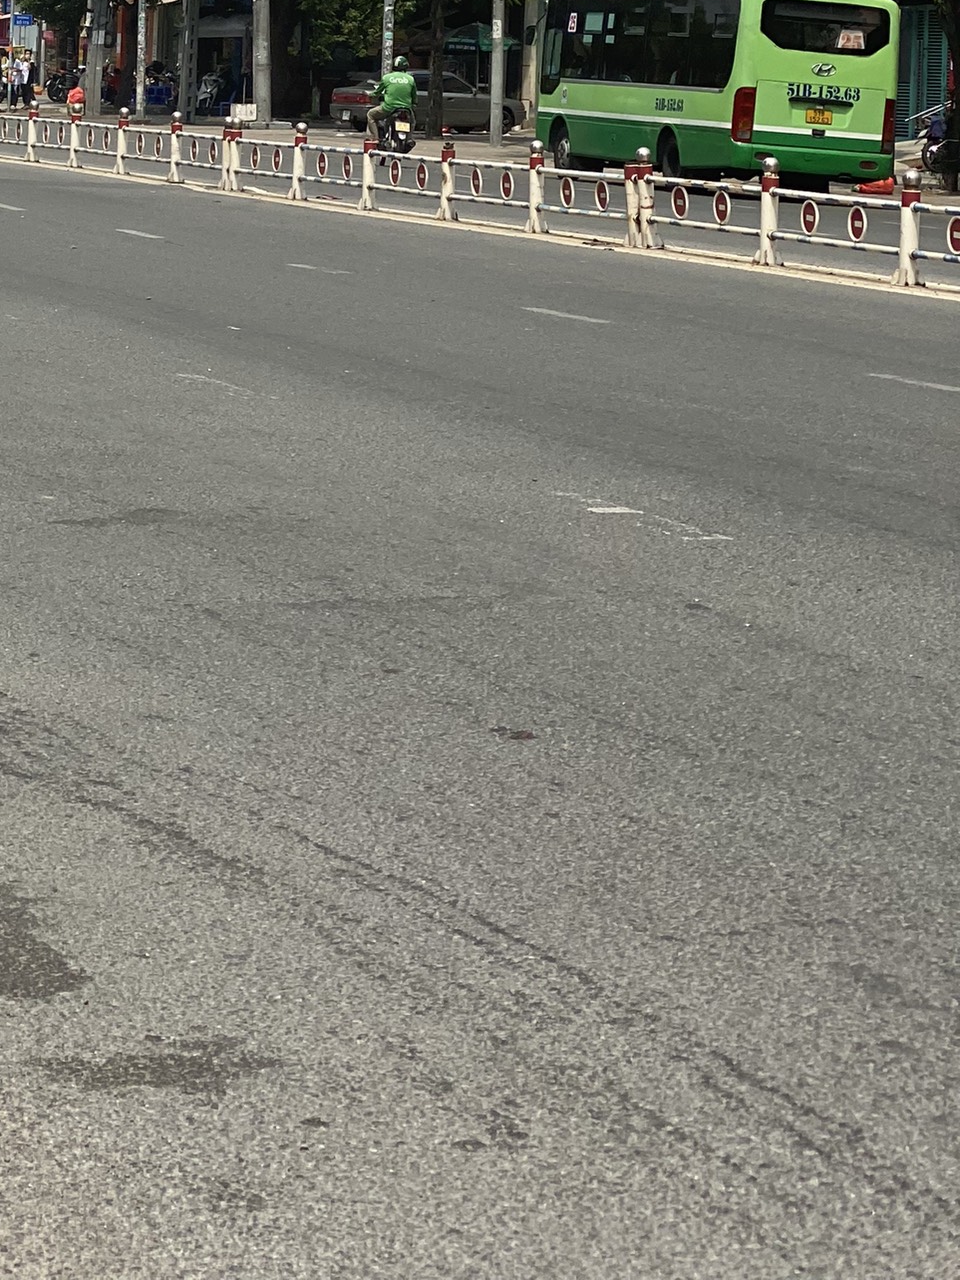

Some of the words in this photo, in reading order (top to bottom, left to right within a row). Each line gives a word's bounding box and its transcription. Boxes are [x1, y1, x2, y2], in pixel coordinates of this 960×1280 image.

[841, 32, 862, 48] 25
[390, 76, 409, 84] Grab
[786, 82, 861, 102] 51B-152.63
